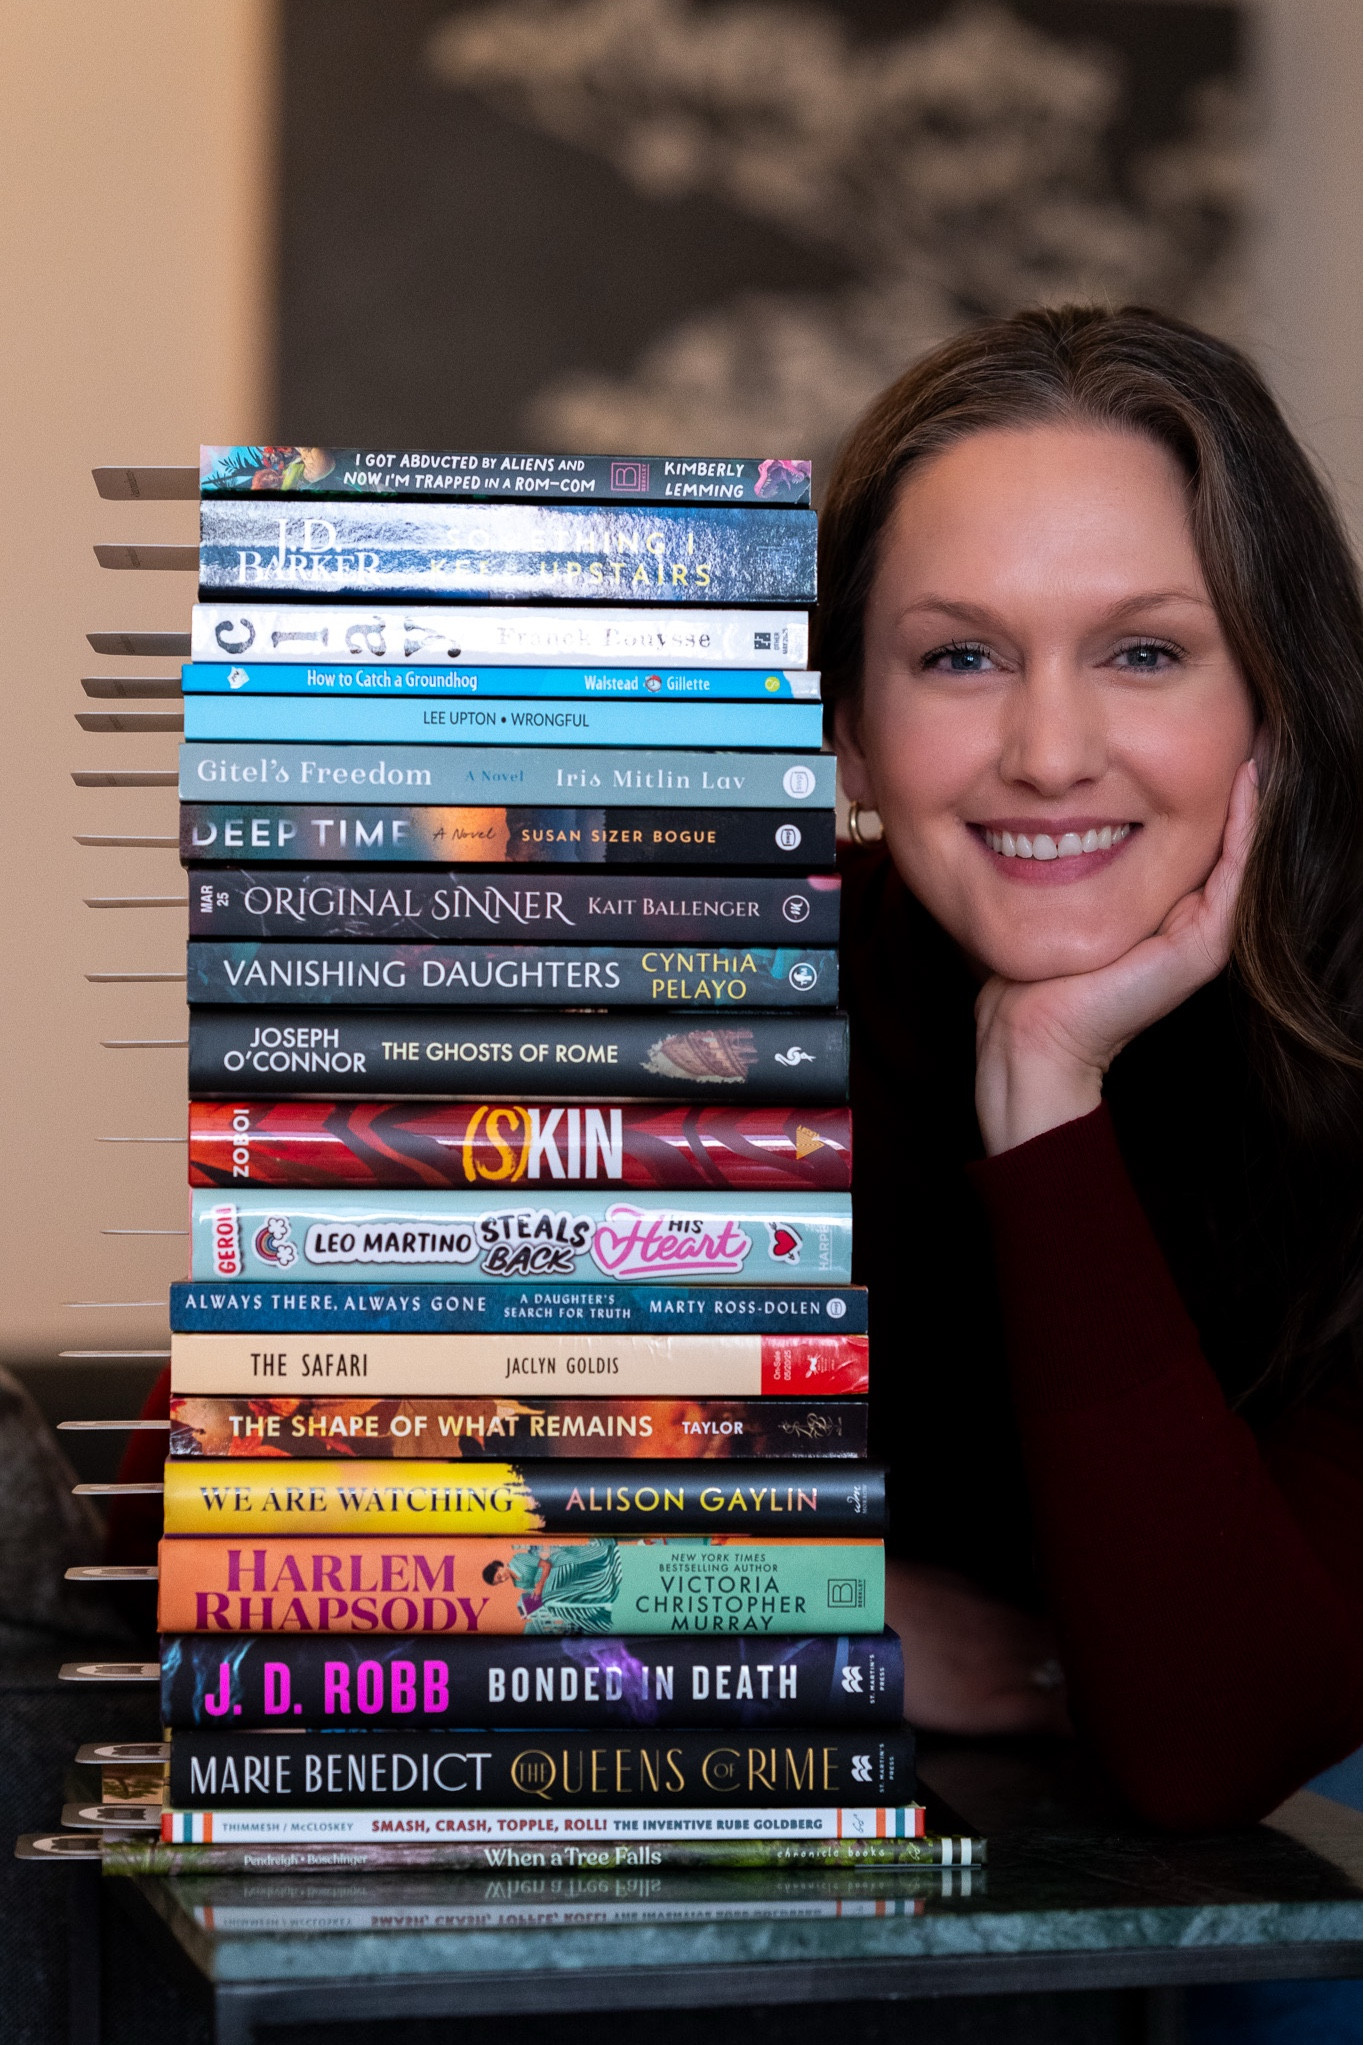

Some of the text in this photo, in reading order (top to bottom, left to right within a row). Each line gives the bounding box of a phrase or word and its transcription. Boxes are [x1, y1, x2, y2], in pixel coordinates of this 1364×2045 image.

[355, 453, 585, 471] I GOT ABDUCTED BY ALIENS AND
[664, 461, 744, 478] KIMBERLY
[343, 471, 595, 493] NOW I'M TRAPPED IN A ROM-COM
[664, 482, 744, 498] LEMMING
[272, 518, 342, 567] J.D.
[447, 528, 694, 556] SOETHING I
[237, 551, 382, 585] BARKER
[539, 561, 712, 587] UPSTAIRS
[307, 670, 478, 692] How to Catch a Groundhog
[584, 675, 711, 691] Walstead Gillette
[424, 711, 496, 726] LEE UPTON
[511, 713, 589, 727] WRONGFUL
[197, 758, 433, 786] Gitel’s Freedom
[465, 769, 524, 783] A Novel
[556, 768, 746, 790] Iris Mitlin Lav
[191, 818, 412, 848] DEEP TIME
[432, 826, 497, 842] A Novel
[521, 829, 718, 844] SUSAN SIZER BOGUE
[200, 885, 213, 913] MAR
[216, 892, 229, 908] 25
[244, 885, 577, 926] ORIGINAL SINNER
[588, 896, 760, 917] KAIT BALLENGER
[223, 959, 621, 989] VANISHING DAUGHTERS
[641, 952, 758, 974] CYNTHIA
[652, 979, 747, 1000] PELAYO
[250, 1027, 340, 1048] JOSEPH
[223, 1051, 367, 1074] O’CONNOR
[381, 1041, 619, 1064] THE GHOSTS OF ROME
[232, 1108, 251, 1178] ZOBOI
[462, 1105, 623, 1184] (S)KIN
[481, 1213, 589, 1247] STEALS
[668, 1217, 703, 1234] HIS
[315, 1232, 472, 1254] LEO MARTINO
[594, 1207, 747, 1270] Heart
[819, 1217, 831, 1271] HARPE
[485, 1248, 575, 1275] BACK
[185, 1294, 487, 1312] ALWAYS THERE, ALWAYS GONE
[520, 1294, 616, 1305] A DAUGHTER'S
[650, 1301, 706, 1314] MARTY
[714, 1301, 821, 1316] ROSS-DOLEN
[503, 1306, 631, 1319] SEARCH FOR TRUTH
[251, 1353, 368, 1377] THE SAFARI
[505, 1357, 620, 1379] JACLYN GOLDIS
[773, 1350, 781, 1381] On-Sale
[229, 1416, 653, 1438] THE SHAPE OF WHAT REMAINS
[682, 1421, 744, 1436] TAYLOR
[200, 1486, 514, 1513] WE ARE WATCHING
[565, 1487, 818, 1512] ALISON GAYLIN
[659, 1564, 778, 1573] BESTSELLING AUTHOR
[671, 1553, 766, 1562] NEW YORK TIMES
[227, 1550, 456, 1592] HARLEM
[661, 1576, 779, 1594] VICTORIA
[195, 1592, 490, 1632] RHAPSODY
[635, 1596, 806, 1613] CHRISTOPHER
[671, 1616, 773, 1631] MURRAY
[205, 1660, 449, 1716] J. D. ROBB
[488, 1665, 798, 1703] BONDED IN DEATH
[190, 1752, 492, 1795] MARIE BENEDICT
[511, 1747, 840, 1799] THE QUEENS OF CRIME
[223, 1823, 354, 1832] THIMMESH McCLOSKEY
[371, 1819, 823, 1834] SMASH, CRASH, TOPPLE, ROLL! THE INVENTIVE RUBE GOLDBERG
[244, 1854, 298, 1867] Pendreigh
[483, 1846, 662, 1867] When a Tree Falls
[777, 1846, 885, 1858] chronicle books
